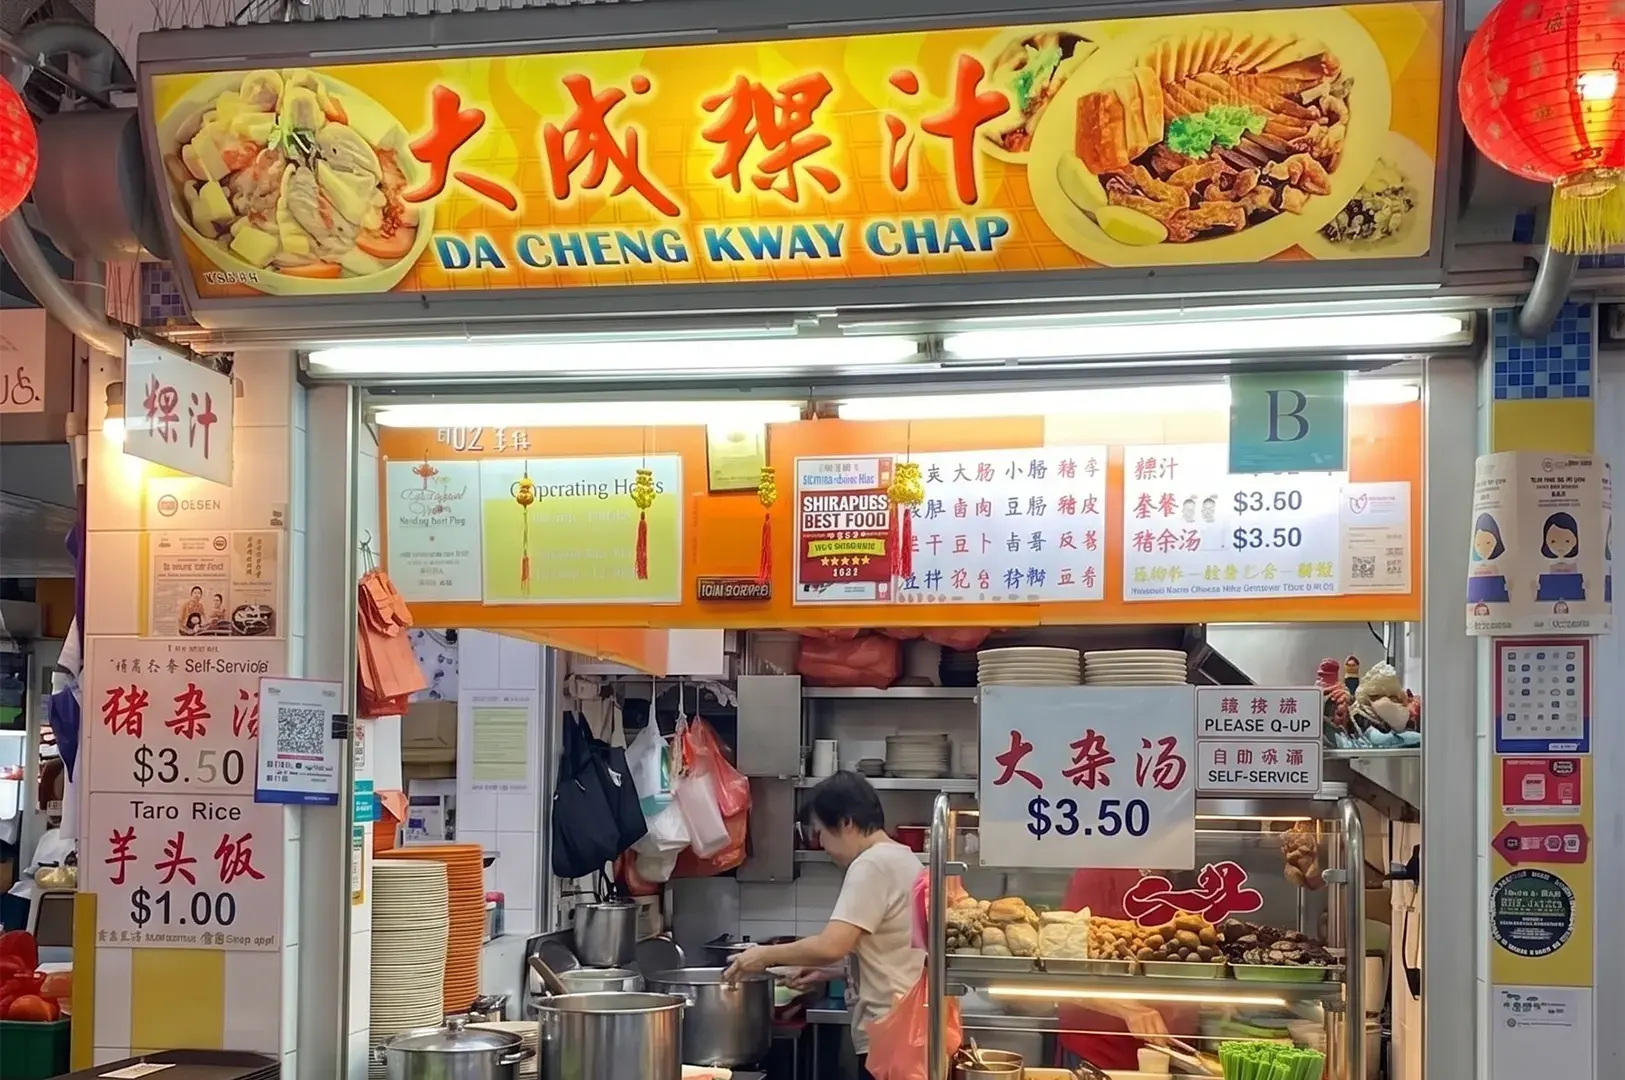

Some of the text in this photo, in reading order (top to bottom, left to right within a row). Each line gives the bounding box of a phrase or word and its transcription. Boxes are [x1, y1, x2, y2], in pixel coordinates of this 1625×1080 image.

[402, 53, 1010, 217] 大成粿汁
[434, 215, 1010, 270] DA CHENG KWAY CHAP
[143, 373, 218, 460] 粿汁
[1263, 389, 1310, 442] B
[804, 512, 887, 529] BEST FOOD
[1233, 490, 1303, 516] $3.50
[1232, 526, 1303, 553] $3.50
[1205, 718, 1311, 732] PLEASE Q-UP
[133, 744, 245, 787] $3.50
[993, 729, 1188, 791] 大杂汤
[1208, 770, 1309, 784] SELF-SERVICE
[130, 801, 242, 821] Taro Rice
[1027, 794, 1151, 841] $3.50
[104, 826, 266, 886] 芋头饭
[130, 886, 237, 929] $1.00
